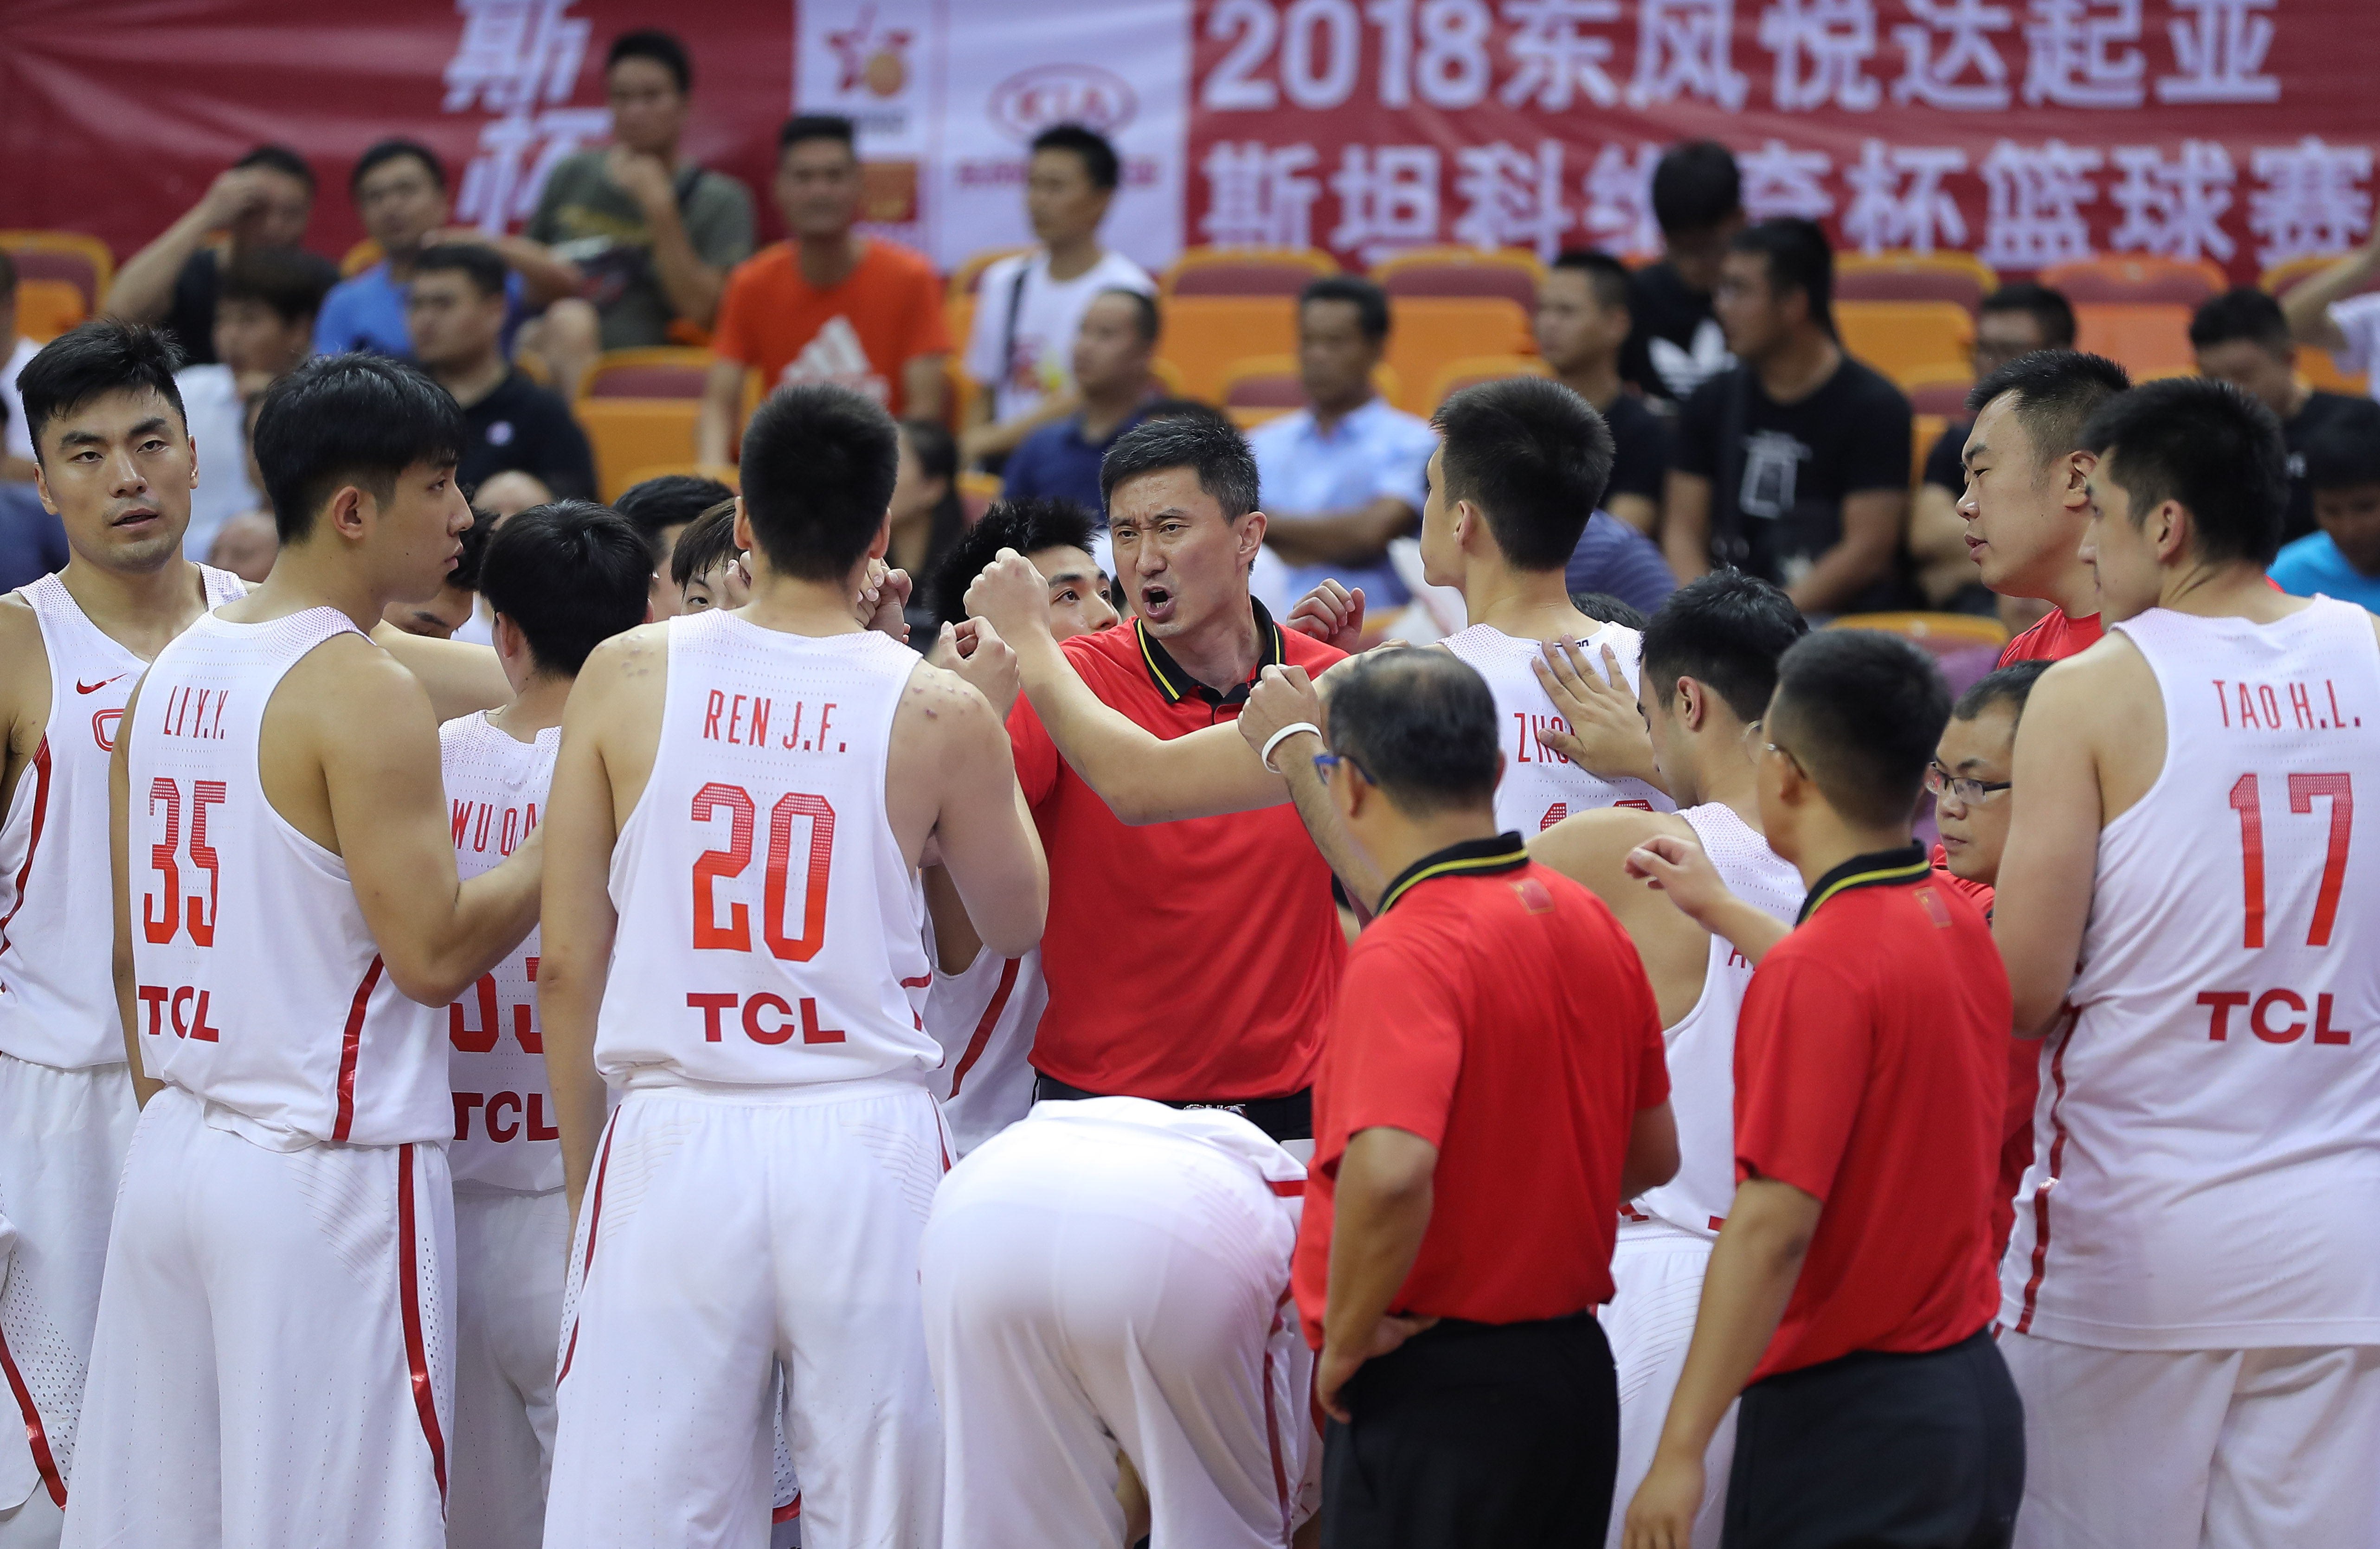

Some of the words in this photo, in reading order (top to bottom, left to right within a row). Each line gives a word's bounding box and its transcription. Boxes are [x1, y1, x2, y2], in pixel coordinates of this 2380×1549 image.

[703, 689, 771, 746] REN
[783, 701, 846, 752] J.F.
[2213, 680, 2281, 729] TAO
[2289, 680, 2361, 729] H.L.
[1514, 713, 1576, 764] ZHO
[451, 798, 493, 852] WU
[143, 777, 227, 948] 35
[691, 782, 836, 963] 20
[2229, 772, 2354, 949] 17
[139, 985, 219, 1043] TCL
[687, 992, 846, 1045] TCL
[2196, 988, 2351, 1046] TCL
[453, 1091, 560, 1143] TCL
